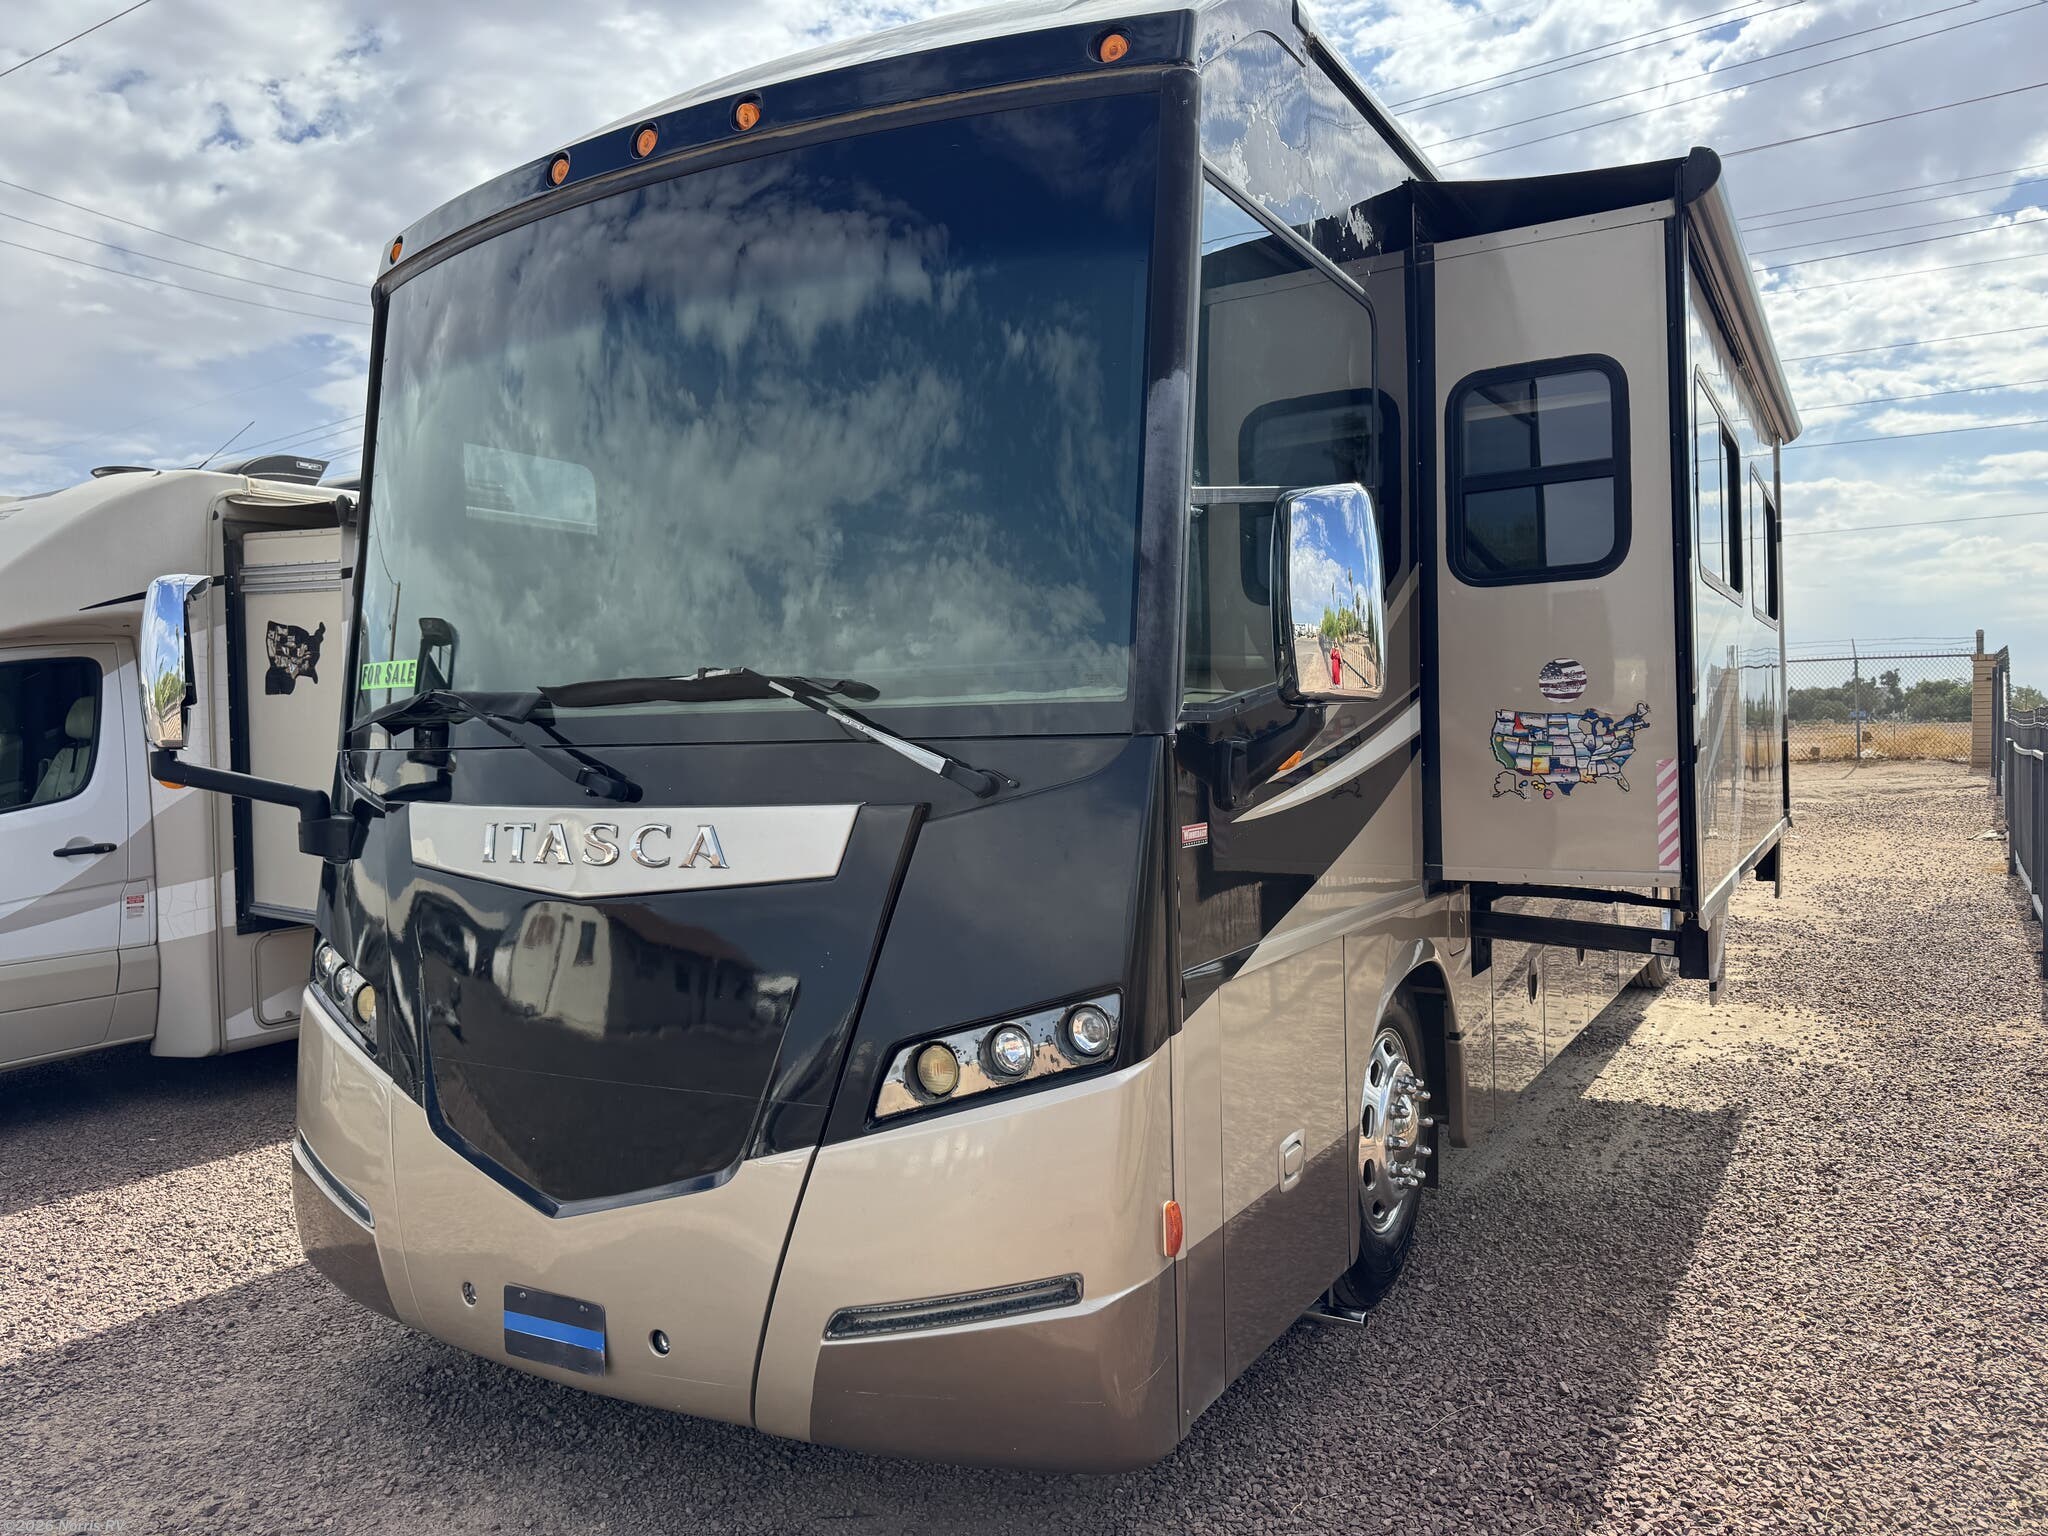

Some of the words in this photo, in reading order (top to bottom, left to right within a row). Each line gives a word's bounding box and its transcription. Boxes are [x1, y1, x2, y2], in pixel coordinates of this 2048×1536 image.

[362, 664, 382, 686] FOR
[384, 662, 415, 685] SALE
[482, 822, 730, 869] ITASCA
